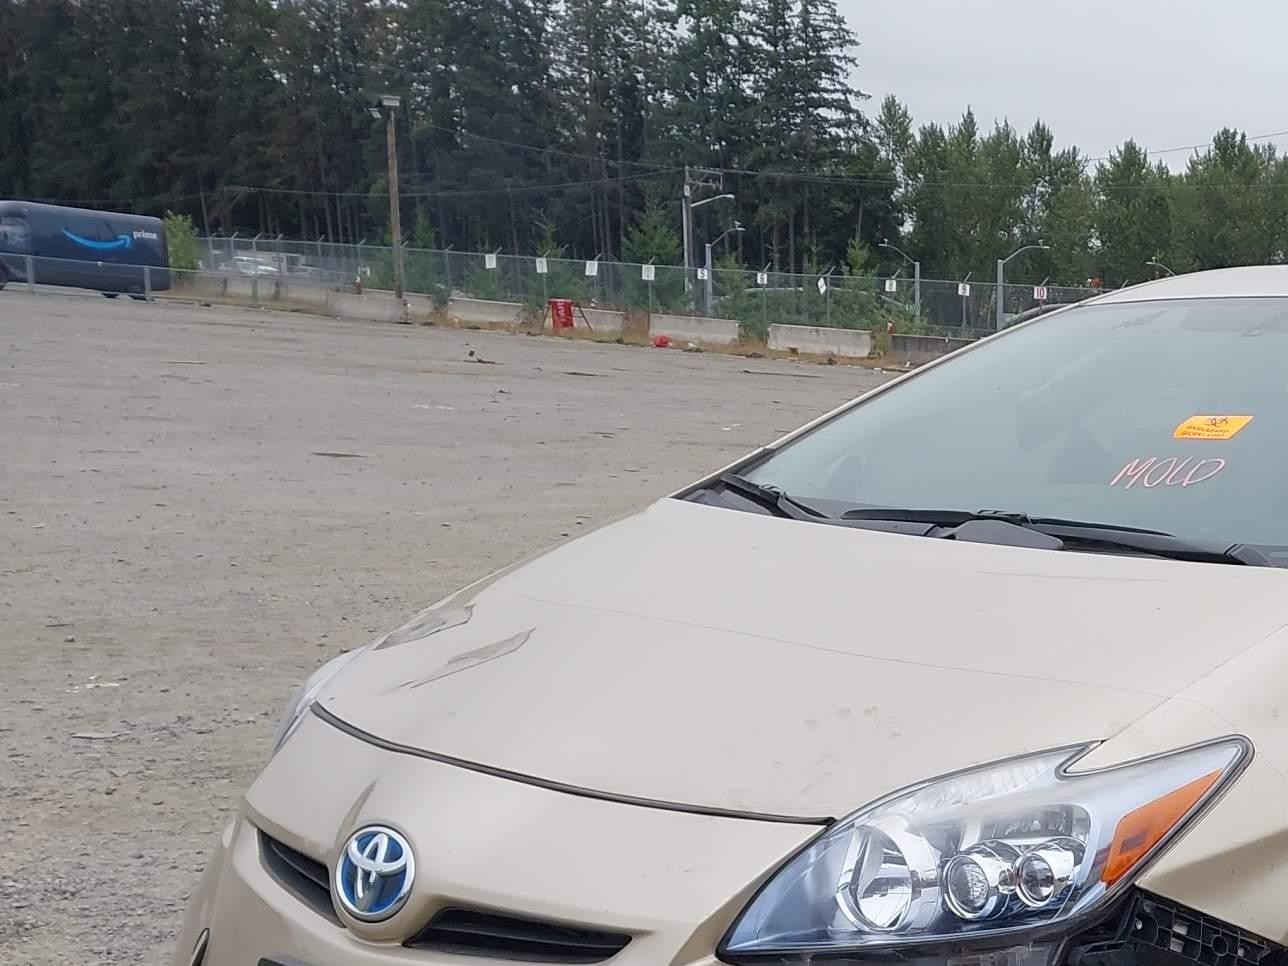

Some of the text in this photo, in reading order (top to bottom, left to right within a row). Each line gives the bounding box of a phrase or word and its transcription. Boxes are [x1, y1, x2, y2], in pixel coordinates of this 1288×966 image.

[132, 230, 158, 240] prime
[699, 269, 707, 280] 5
[960, 284, 968, 296] 9
[1036, 288, 1045, 298] 10
[1110, 458, 1225, 488] MOLD
